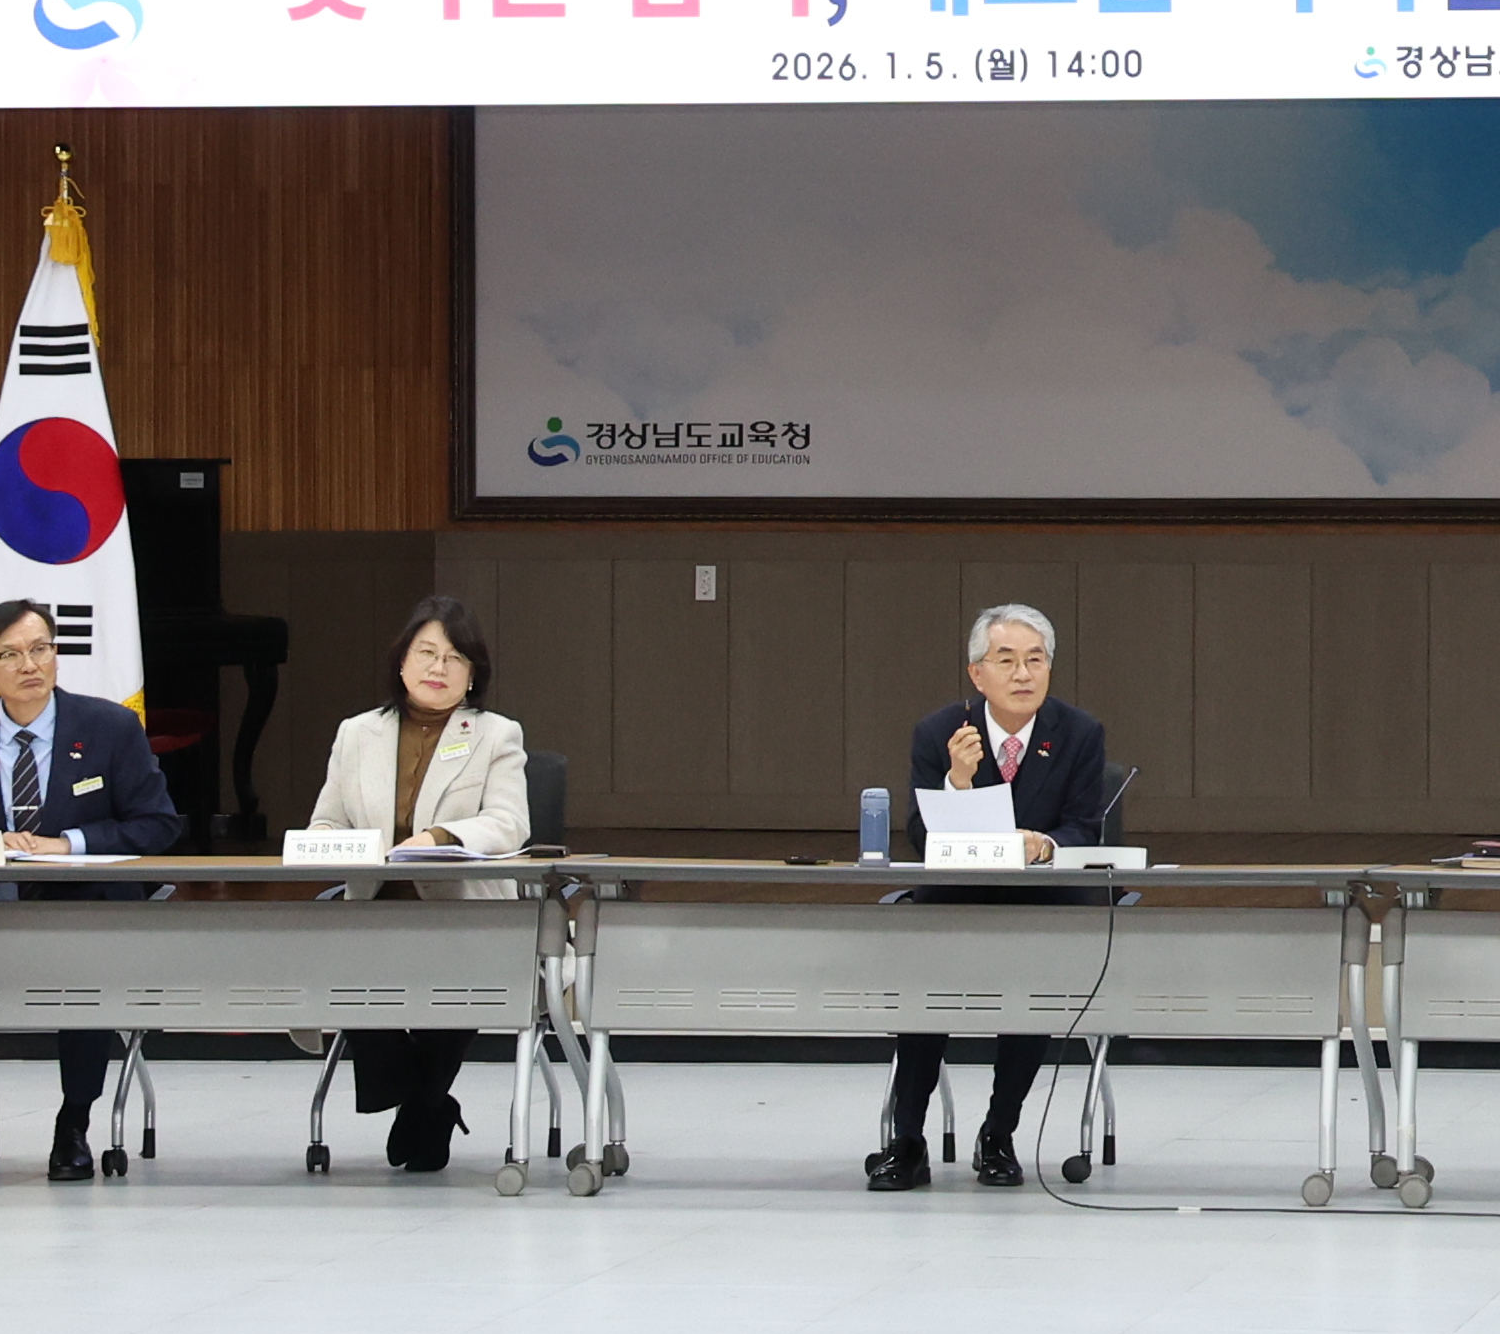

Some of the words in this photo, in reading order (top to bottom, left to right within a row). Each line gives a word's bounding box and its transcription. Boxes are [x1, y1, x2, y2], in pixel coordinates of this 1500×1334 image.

[771, 52, 868, 82] 2026.
[885, 52, 913, 80] 1.
[925, 52, 958, 80] 5.
[975, 48, 1029, 83] (월)
[1047, 49, 1143, 79] 14:00
[586, 421, 811, 451] 경상남도교육청
[585, 453, 697, 466] GYEONGSANGNAMDO
[699, 453, 734, 465] OFFICE
[736, 453, 749, 465] OF
[751, 453, 811, 466] EDUCATION
